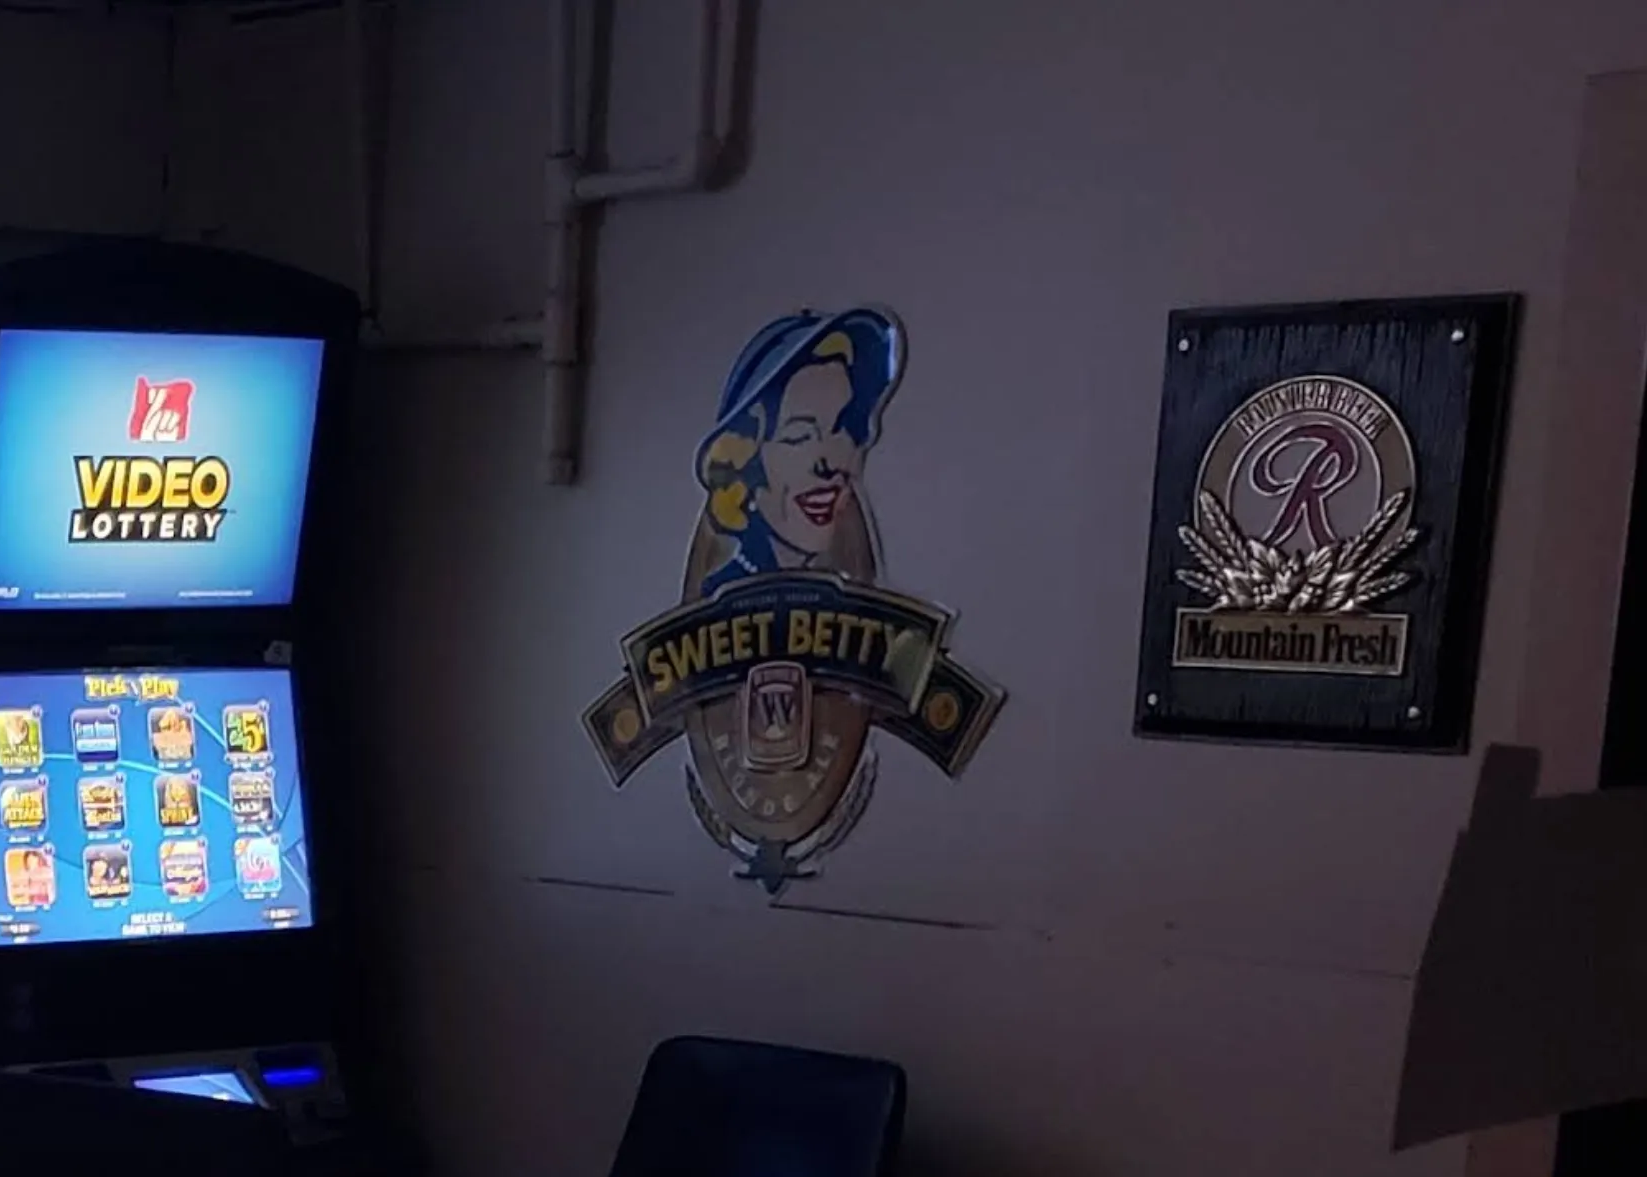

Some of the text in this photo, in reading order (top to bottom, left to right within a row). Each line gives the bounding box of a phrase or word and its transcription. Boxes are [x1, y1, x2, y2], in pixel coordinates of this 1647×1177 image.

[77, 458, 229, 509] VIDEO
[72, 511, 224, 539] LOTTERY
[647, 609, 896, 692] SWEET BETTY
[1185, 617, 1398, 667] Mountain Fresh
